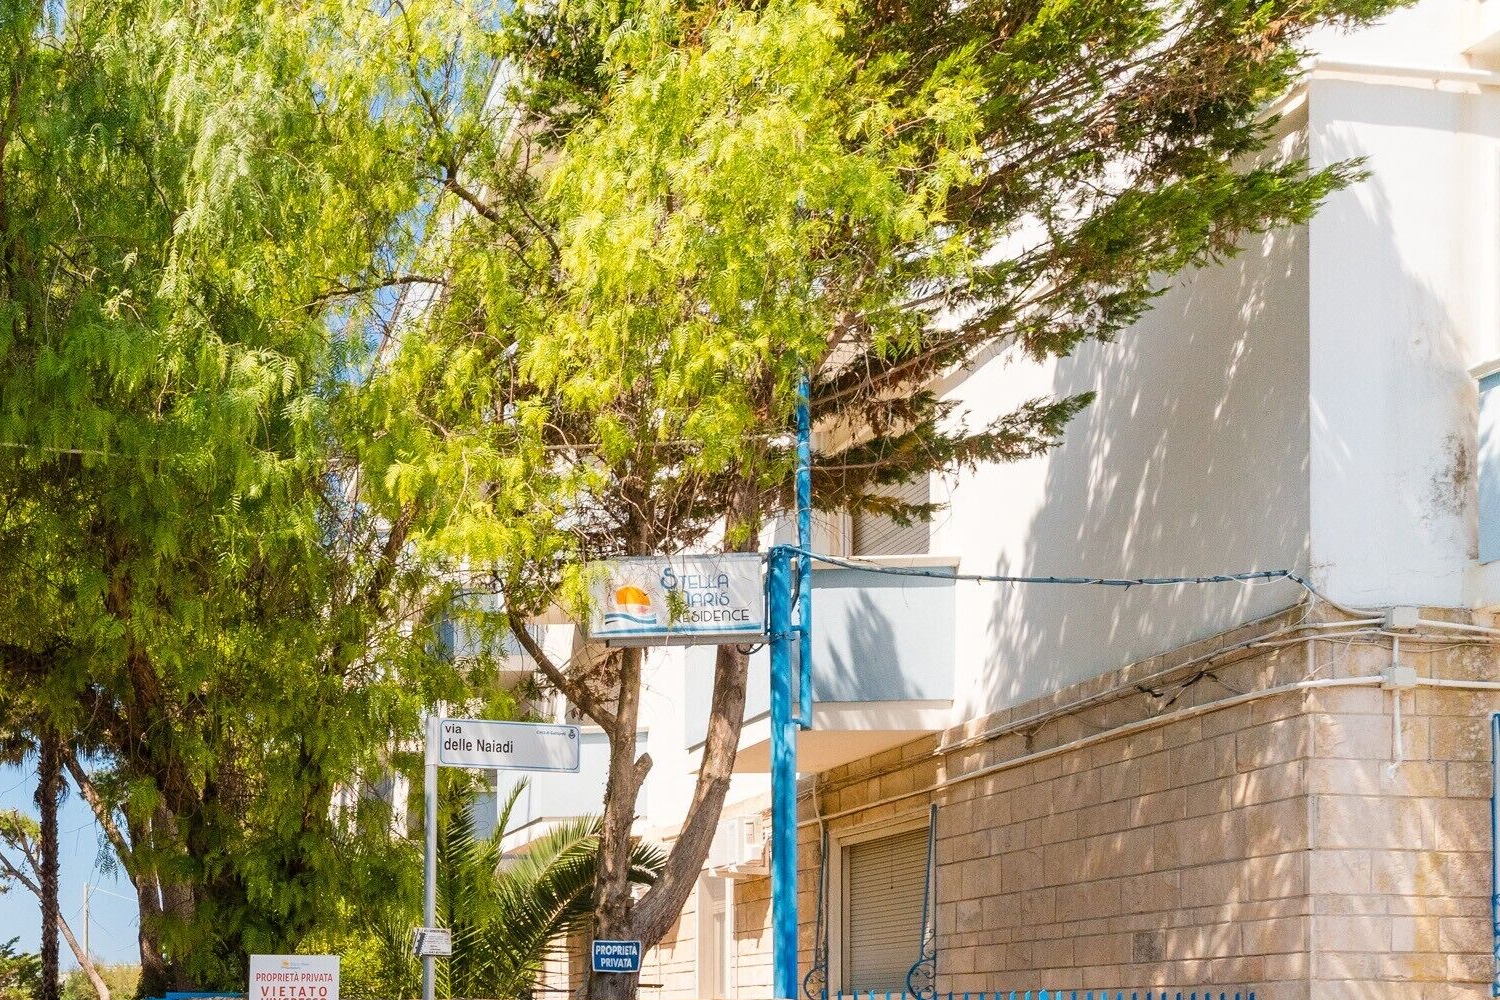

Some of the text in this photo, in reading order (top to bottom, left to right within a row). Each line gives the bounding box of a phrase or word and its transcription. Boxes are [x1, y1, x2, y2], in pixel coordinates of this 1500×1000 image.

[660, 567, 729, 590] STELLA
[675, 609, 750, 623] ESIDENCE
[445, 723, 462, 734] via
[444, 738, 513, 753] delle Naiadi
[595, 942, 638, 955] PROPRIETÀ
[600, 958, 632, 968] PRIVATA
[256, 971, 333, 982] PROPRIETÀ PRIVATA
[260, 986, 328, 997] VIETATO
